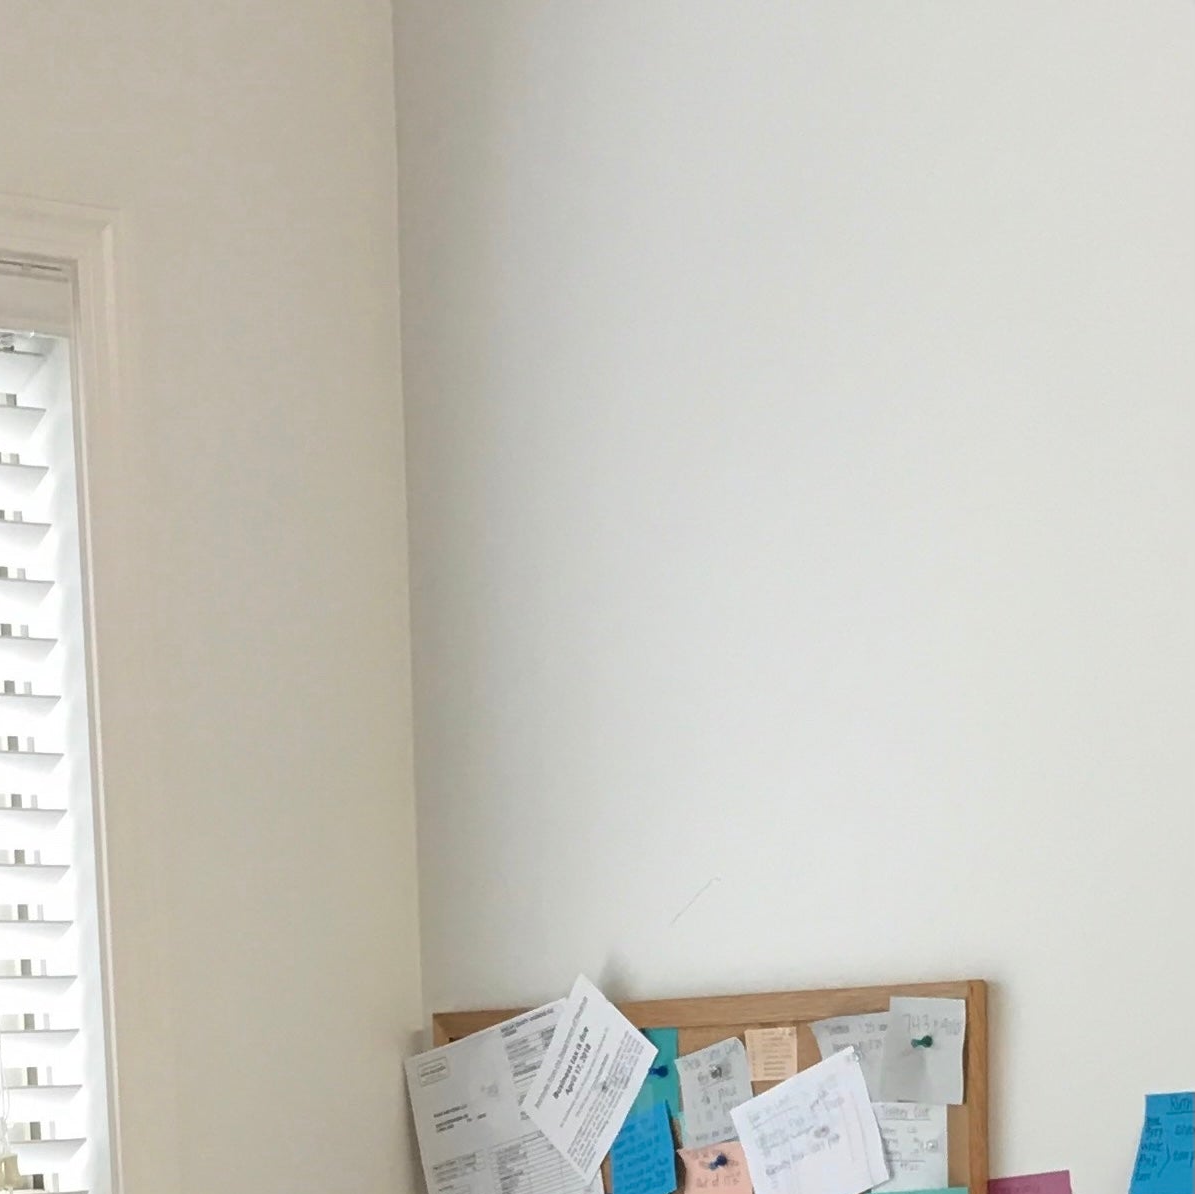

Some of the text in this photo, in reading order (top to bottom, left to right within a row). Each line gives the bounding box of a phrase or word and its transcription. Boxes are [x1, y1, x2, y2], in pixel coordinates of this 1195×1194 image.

[552, 1064, 573, 1100] Business
[569, 1050, 579, 1065] tax
[579, 1025, 589, 1043] due
[565, 1074, 578, 1096] April
